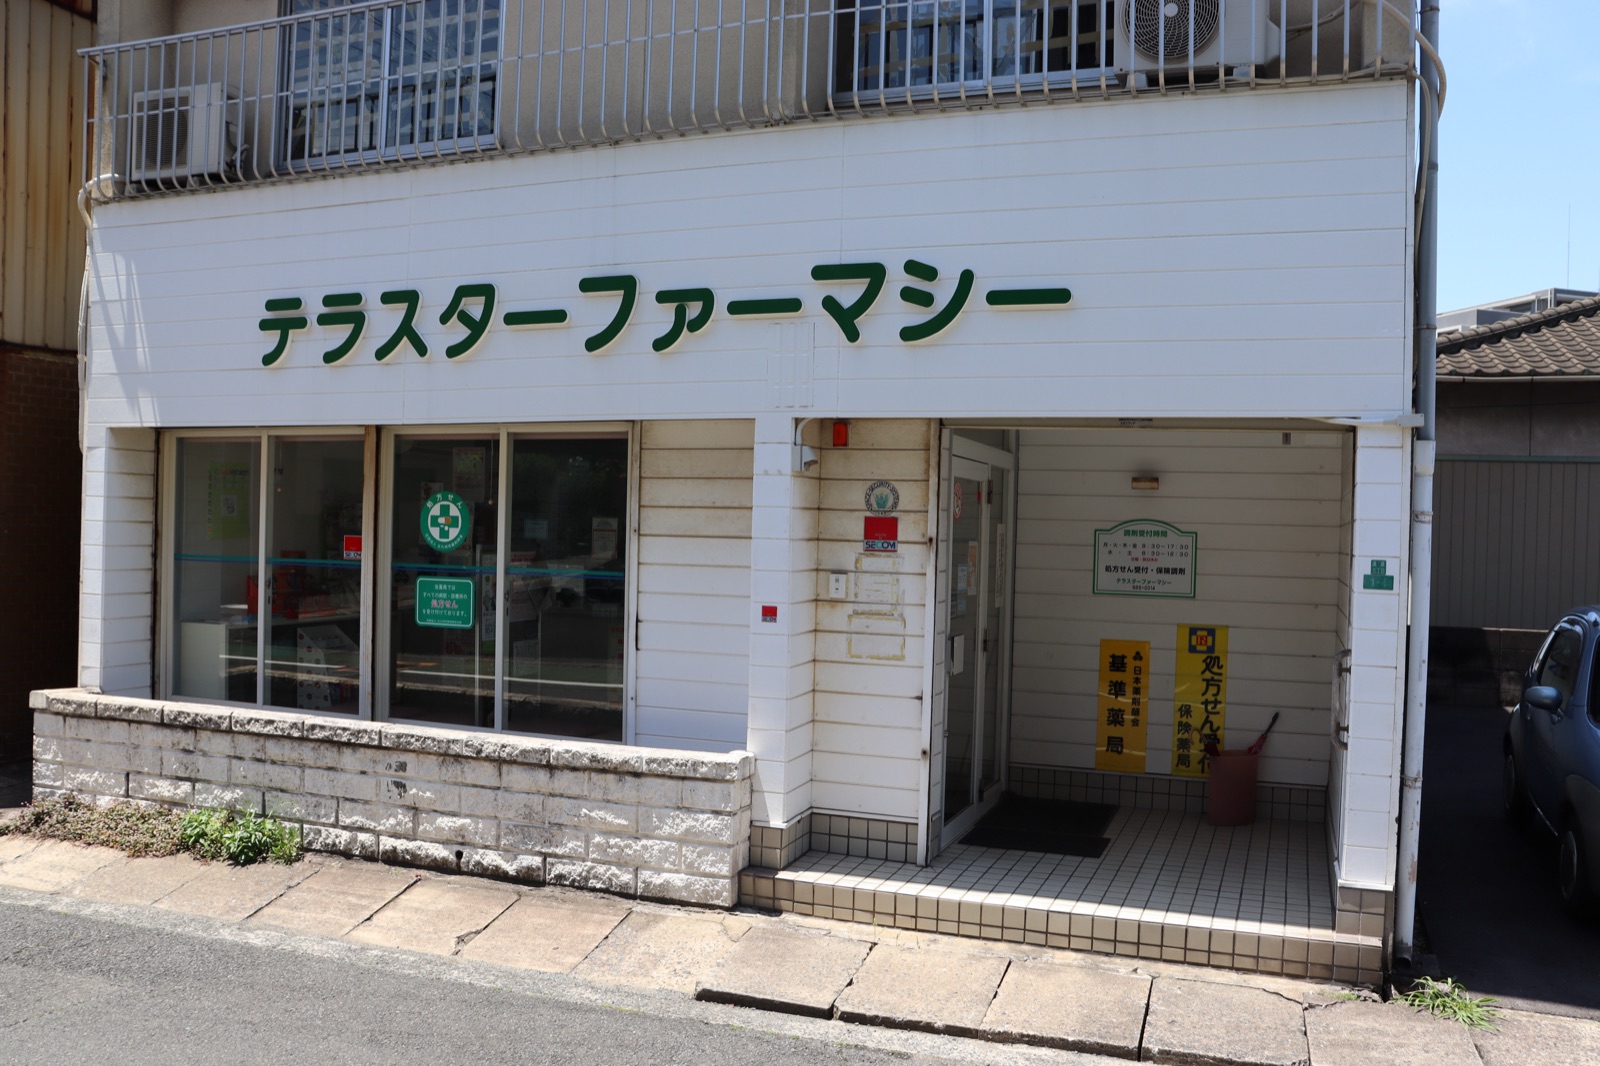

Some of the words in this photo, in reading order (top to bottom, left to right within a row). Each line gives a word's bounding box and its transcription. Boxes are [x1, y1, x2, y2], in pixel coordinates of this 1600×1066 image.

[259, 260, 1072, 367] テラスターファーマシー
[426, 493, 463, 509] 処方せん
[1123, 529, 1168, 538] 調剤受付時間
[865, 540, 896, 549] SECOM
[1104, 565, 1186, 576] 処方せん受付・保険調剤
[431, 599, 459, 609] 処方せん
[1106, 654, 1128, 755] 基準薬局
[1131, 666, 1142, 728] 日本薬剤師会
[1176, 704, 1193, 769] 保険薬局
